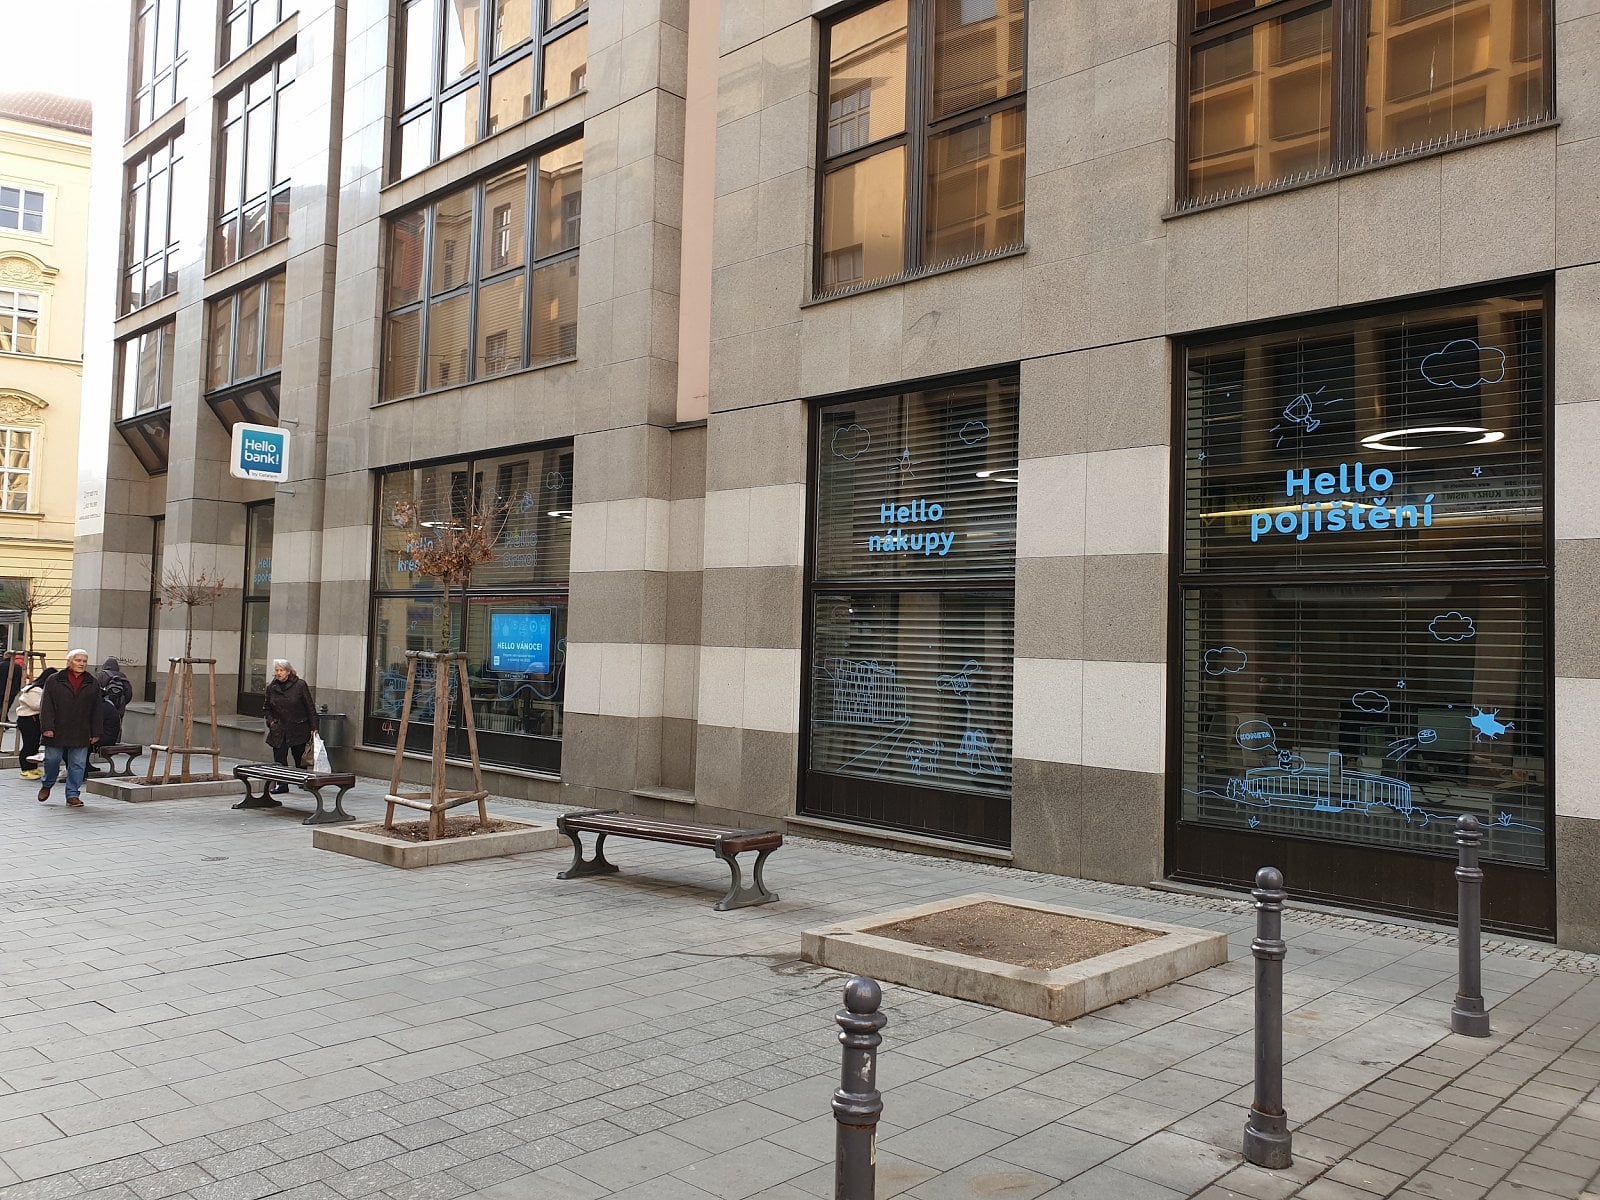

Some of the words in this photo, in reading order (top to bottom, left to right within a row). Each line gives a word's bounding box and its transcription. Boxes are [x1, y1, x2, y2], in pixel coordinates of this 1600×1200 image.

[244, 449, 279, 465] bank!
[245, 438, 277, 453] Hello
[1285, 462, 1394, 497] Hello
[880, 499, 943, 524] Hello
[1250, 493, 1436, 543] pojištění
[868, 528, 955, 557] nákupy
[497, 641, 515, 650] HELLO
[516, 640, 543, 651] VÁNOCE!
